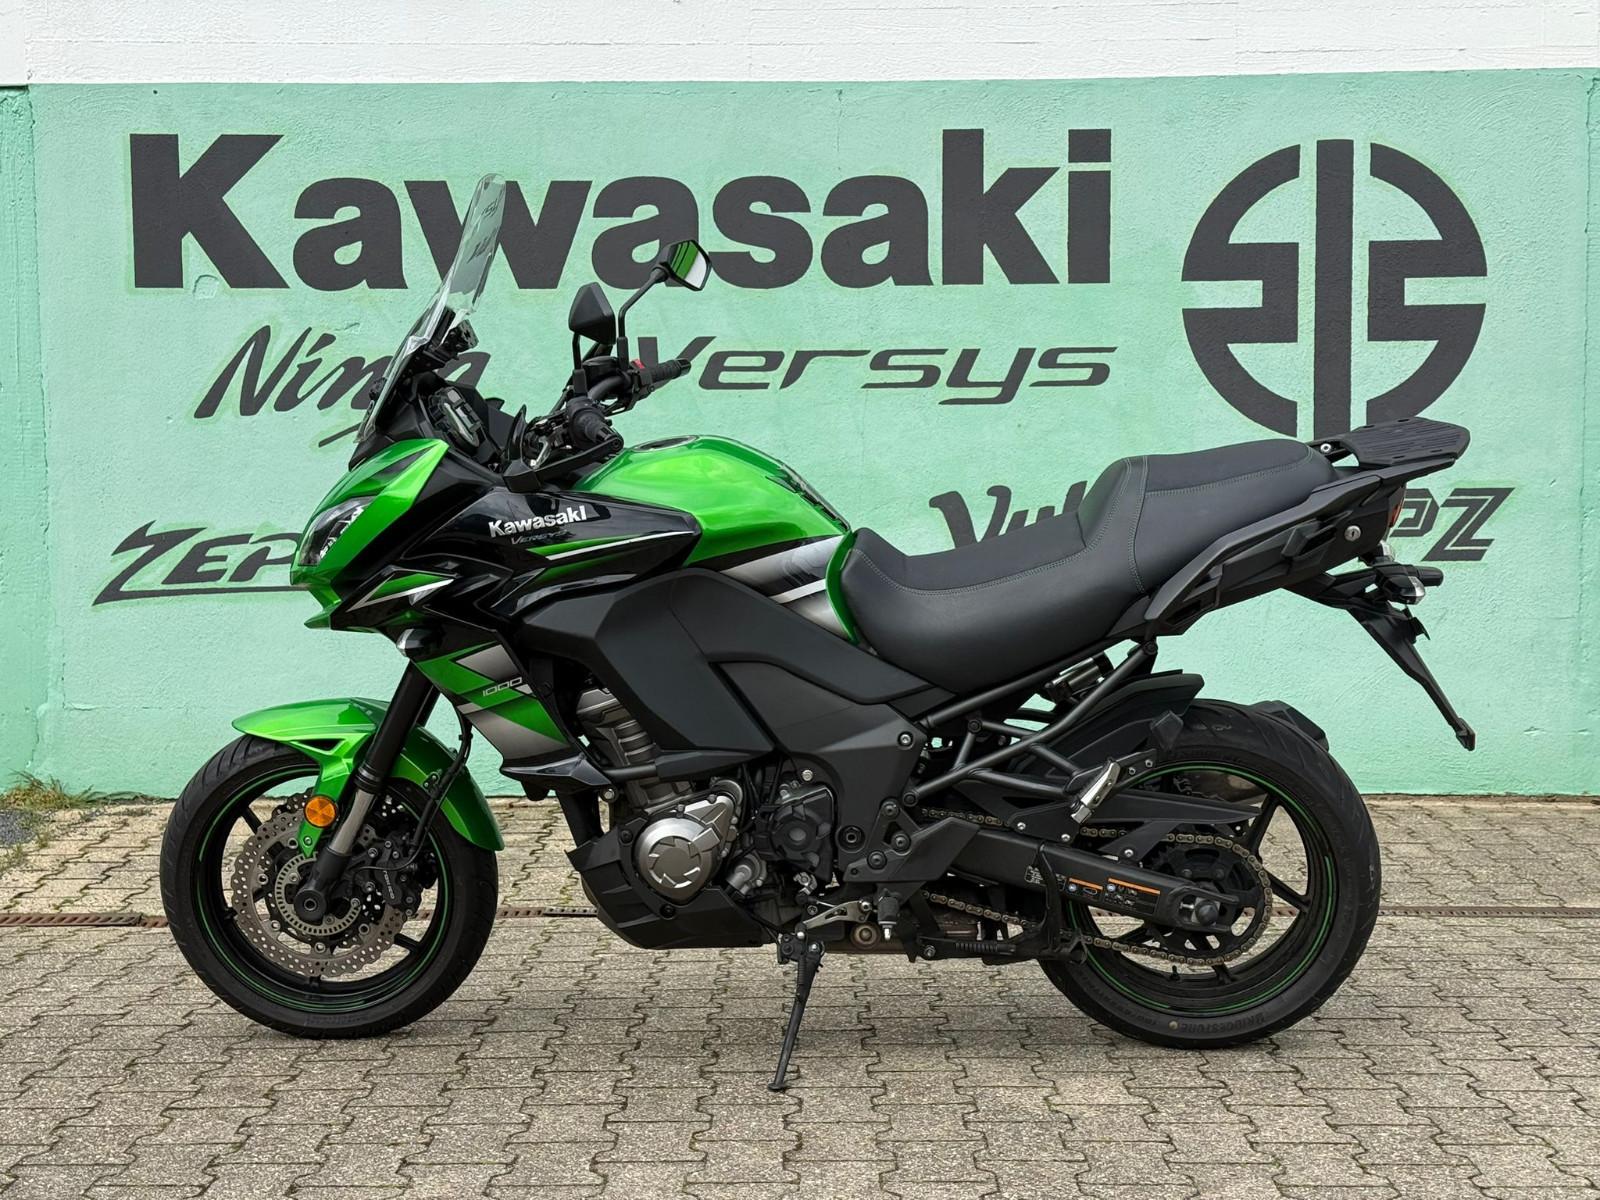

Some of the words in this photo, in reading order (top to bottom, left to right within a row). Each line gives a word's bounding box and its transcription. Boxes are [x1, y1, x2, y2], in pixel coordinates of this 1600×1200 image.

[130, 128, 1112, 290] Kawasaki
[636, 335, 1118, 405] Versys
[488, 504, 588, 538] Kawasaki
[482, 676, 523, 697] 1000
